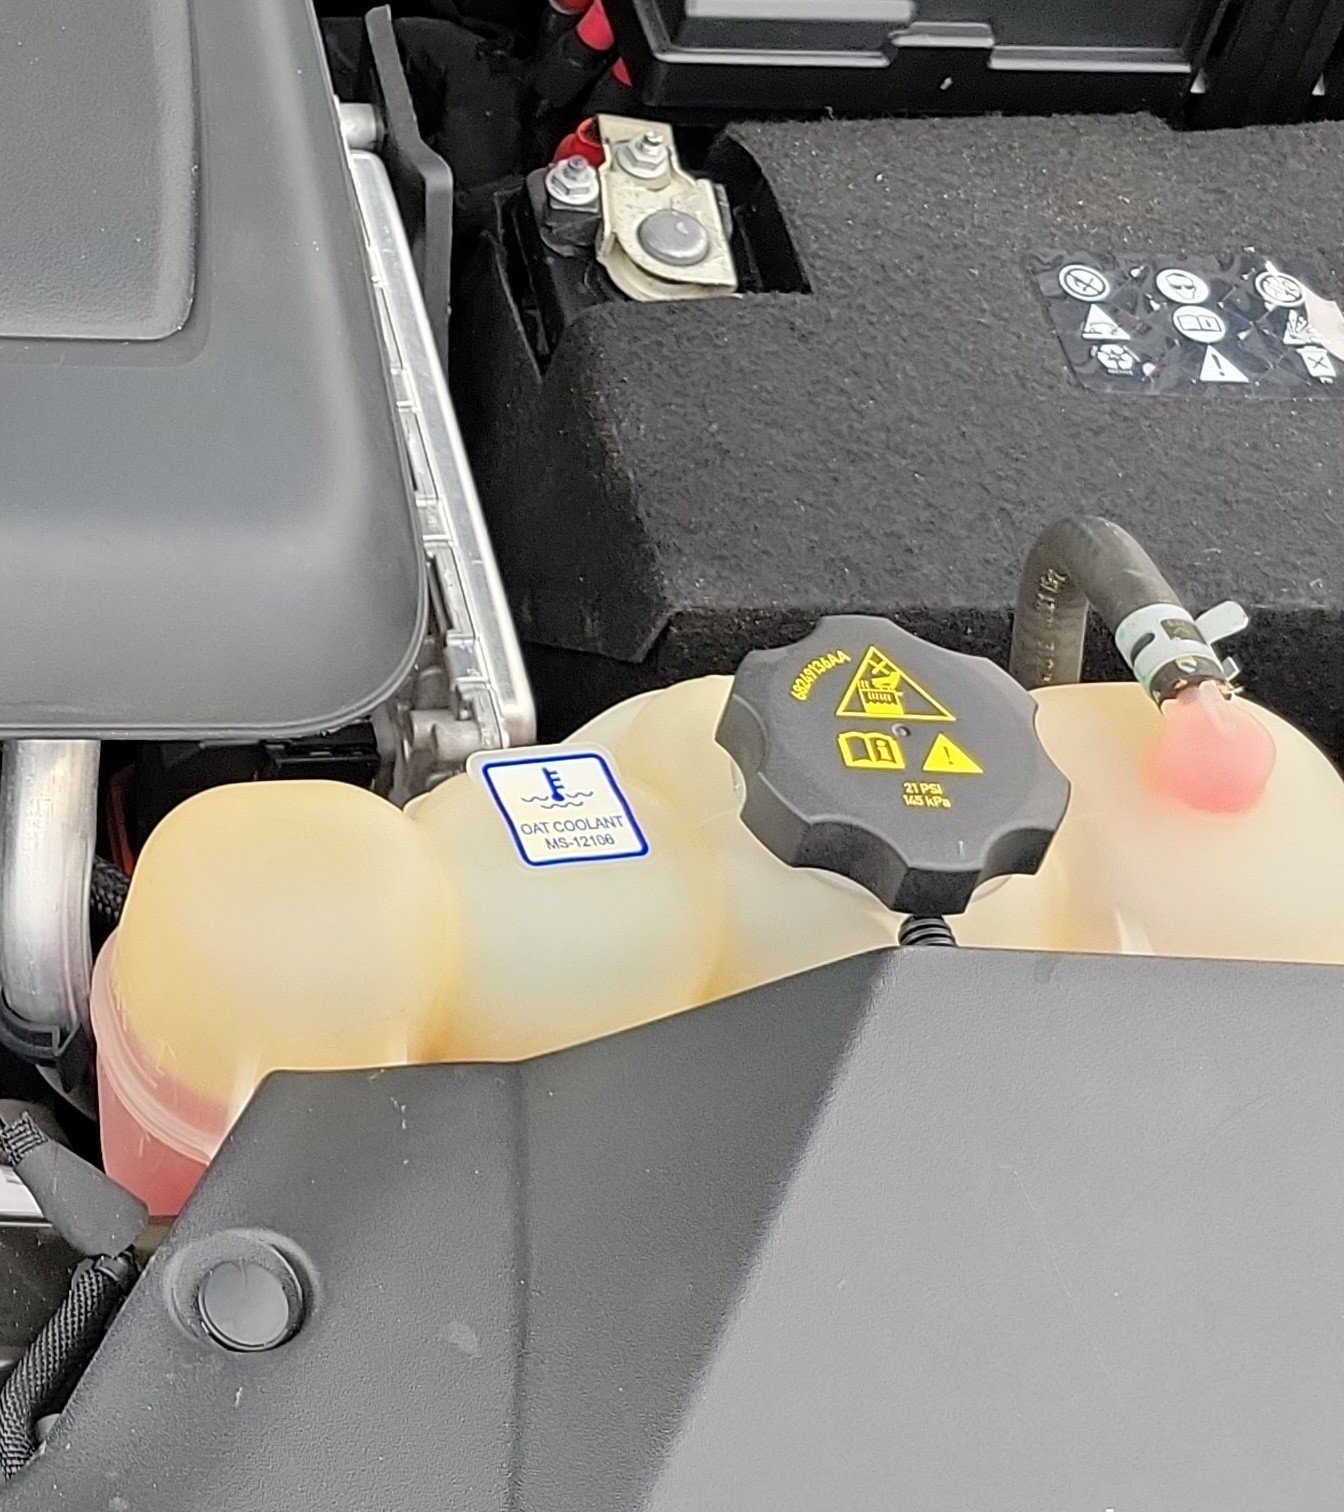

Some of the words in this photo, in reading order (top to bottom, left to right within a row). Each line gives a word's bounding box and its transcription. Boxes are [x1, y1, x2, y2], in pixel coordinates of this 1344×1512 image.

[790, 650, 852, 702] 68249136AA
[903, 782, 919, 794] 21
[919, 782, 943, 795] PSI
[902, 794, 924, 806] 145
[924, 795, 952, 809] kPa
[520, 821, 552, 836] OAT
[553, 815, 624, 834] COOLANT
[545, 833, 615, 850] MS-12106
